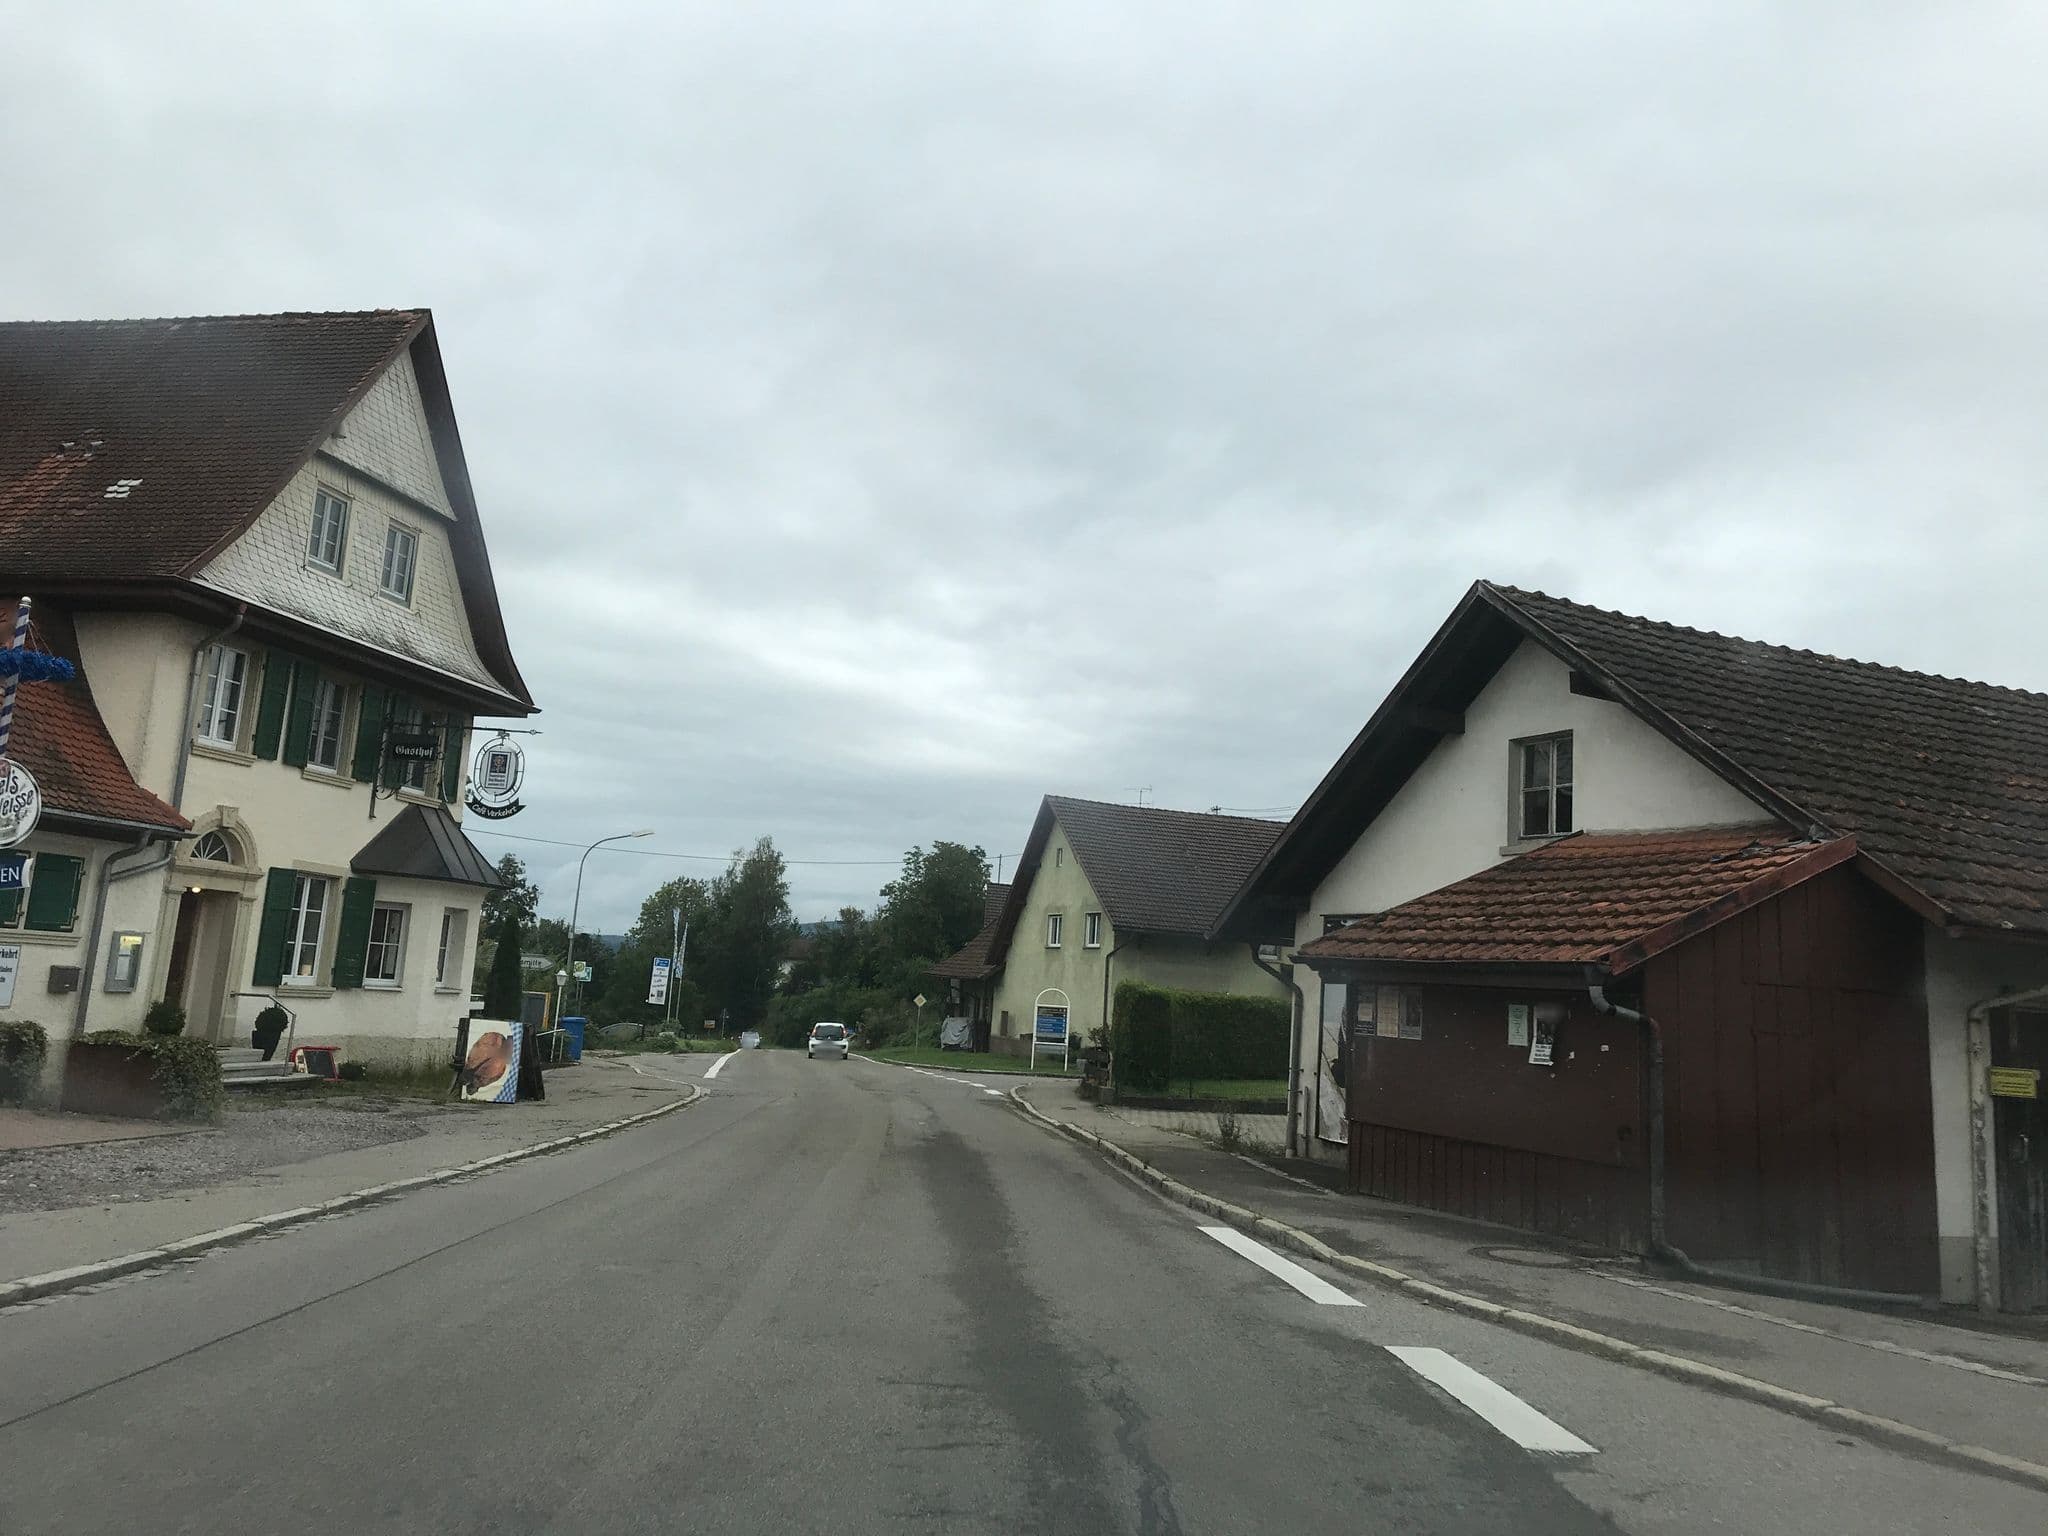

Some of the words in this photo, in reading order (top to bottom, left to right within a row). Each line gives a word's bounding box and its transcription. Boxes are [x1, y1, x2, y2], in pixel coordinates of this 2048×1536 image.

[395, 745, 434, 758] Gasthof
[0, 790, 33, 816] eisse
[472, 804, 487, 815] Café
[487, 806, 517, 817] Verkehrt
